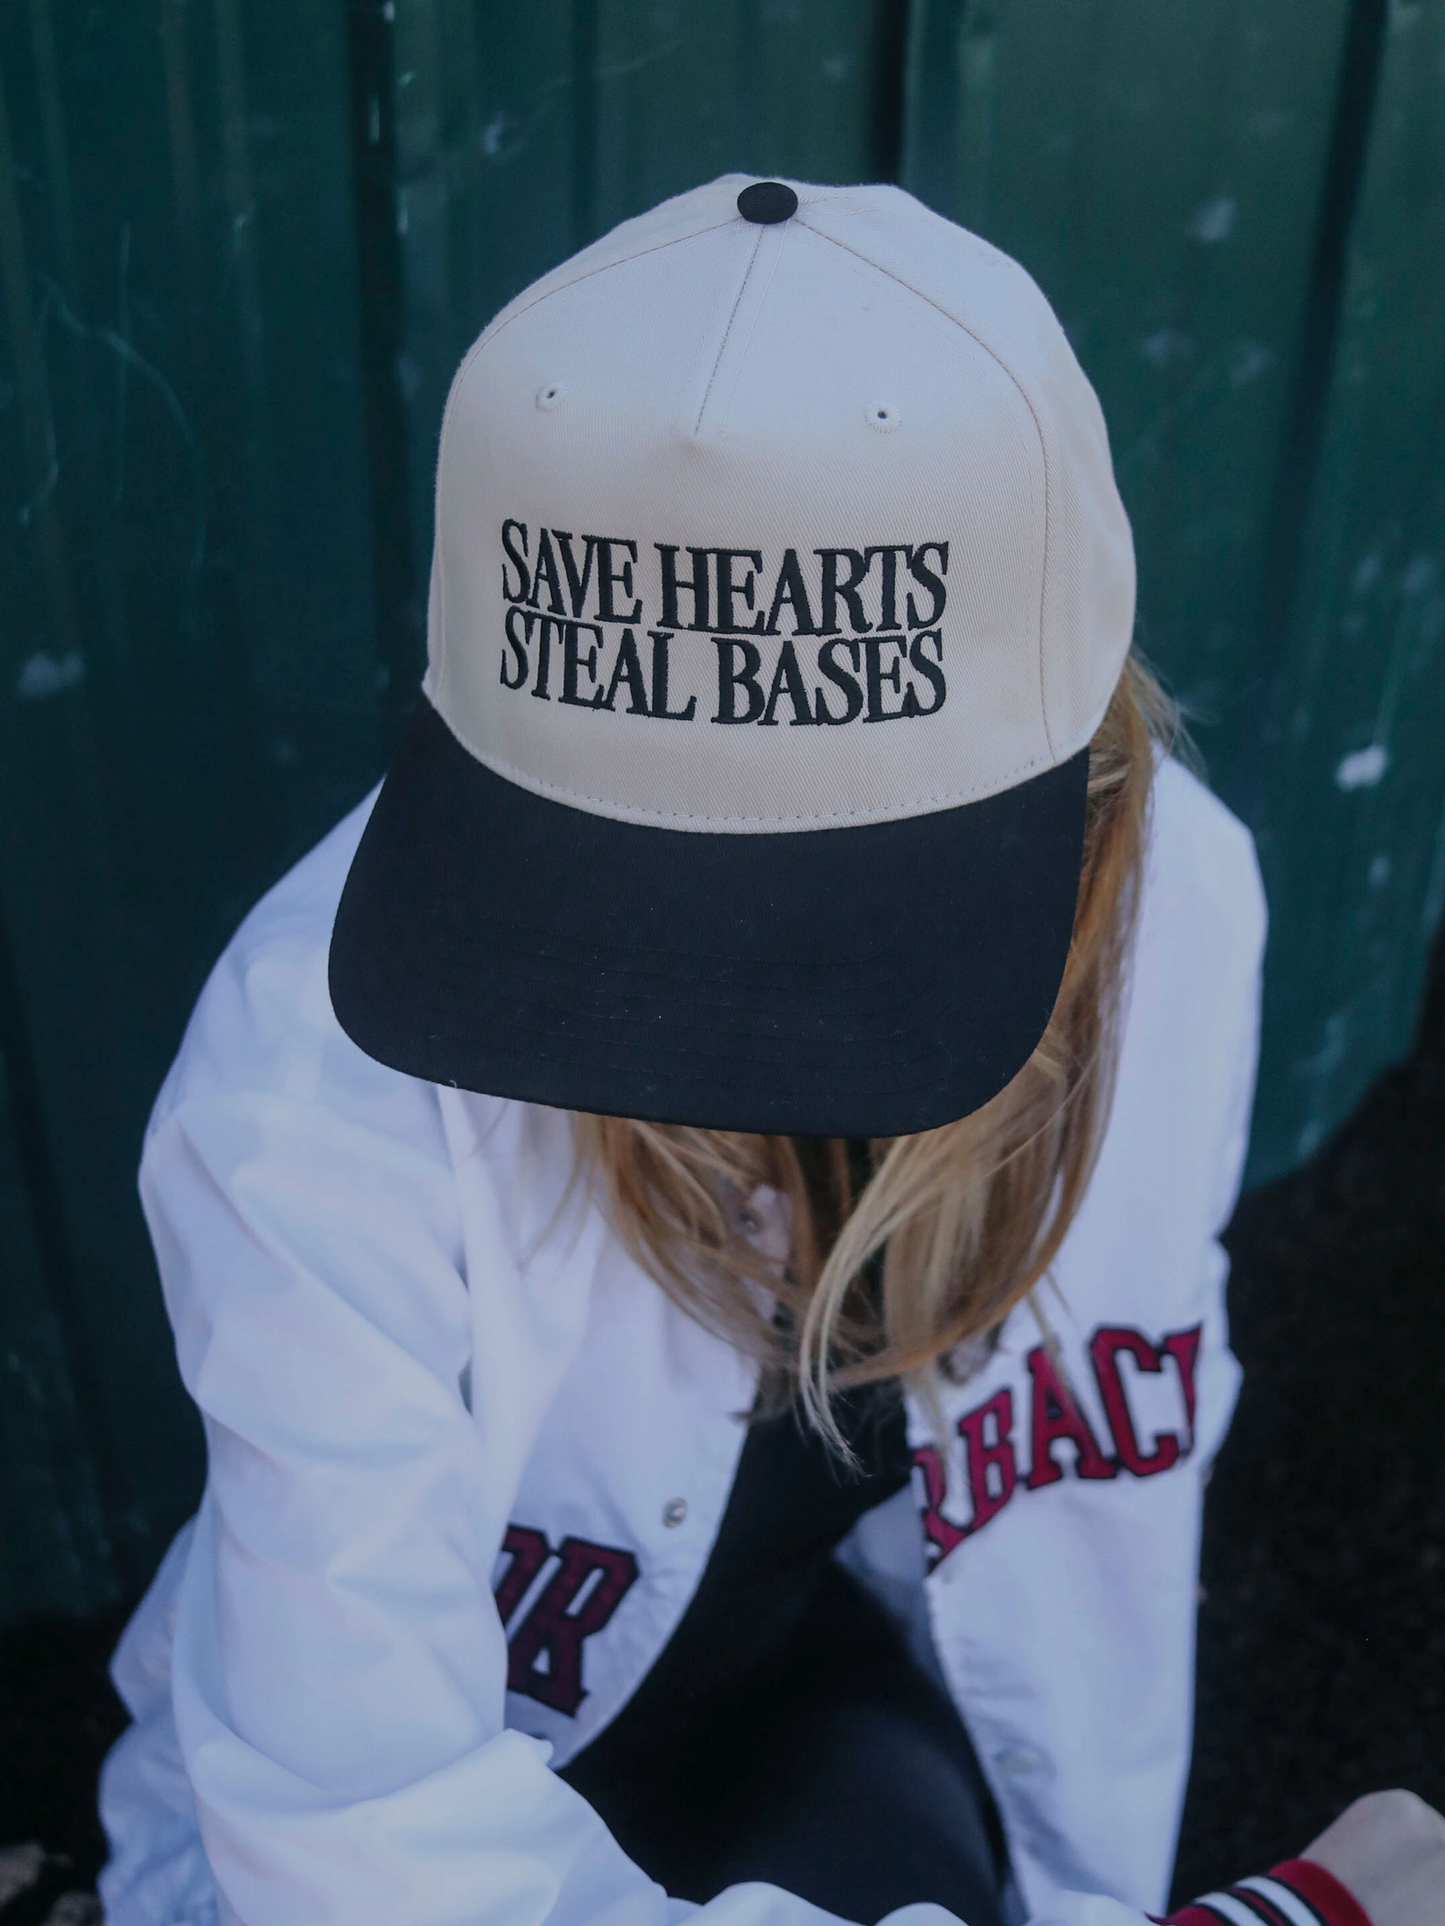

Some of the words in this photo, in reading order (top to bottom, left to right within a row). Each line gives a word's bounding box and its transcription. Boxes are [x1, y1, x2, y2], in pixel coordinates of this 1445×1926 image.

[501, 518, 643, 625] SAVE
[653, 541, 949, 636] HEARTS
[500, 605, 697, 721] STEAL
[711, 628, 947, 726] BASES
